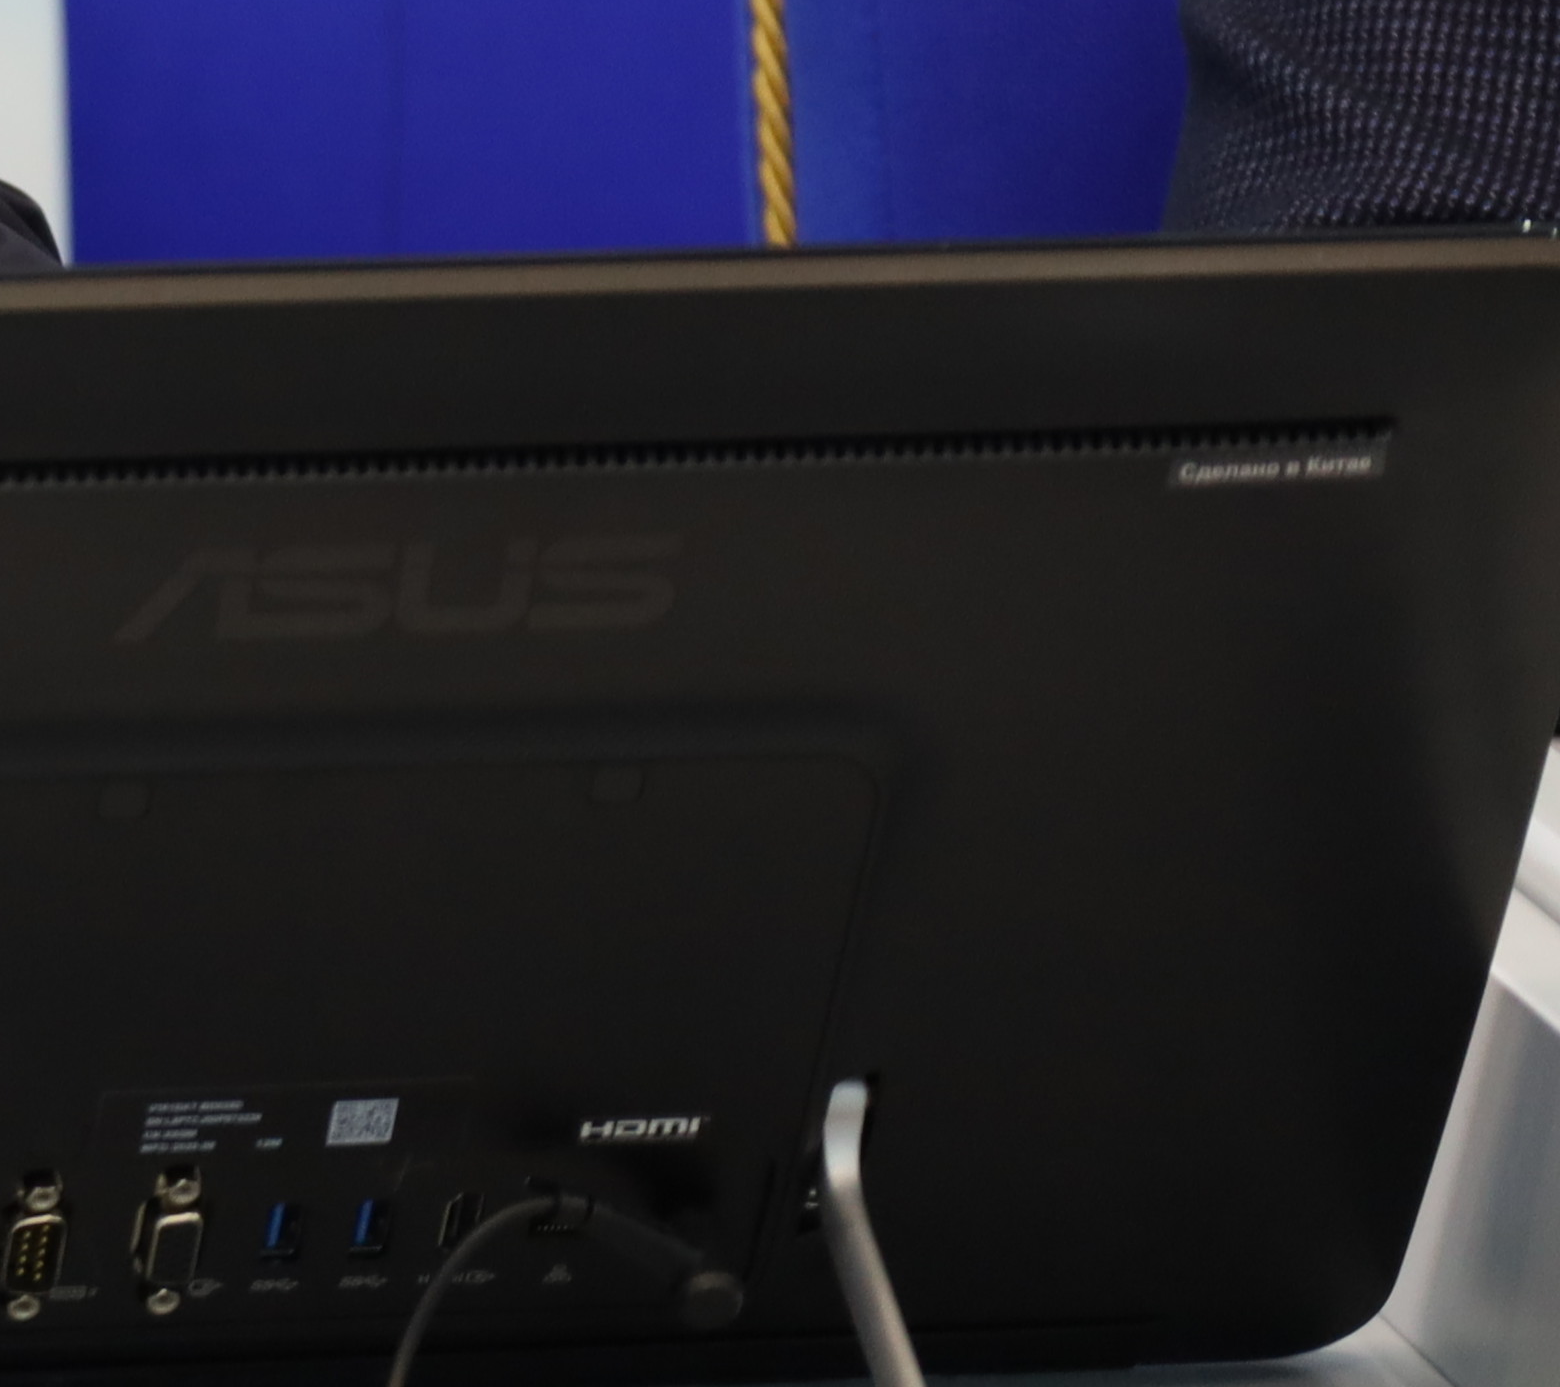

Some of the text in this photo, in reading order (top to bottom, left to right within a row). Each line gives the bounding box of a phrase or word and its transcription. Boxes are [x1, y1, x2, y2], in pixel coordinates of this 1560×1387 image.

[1178, 461, 1281, 486] Сделано
[115, 531, 683, 642] ASUS
[579, 1116, 702, 1139] HDMI
